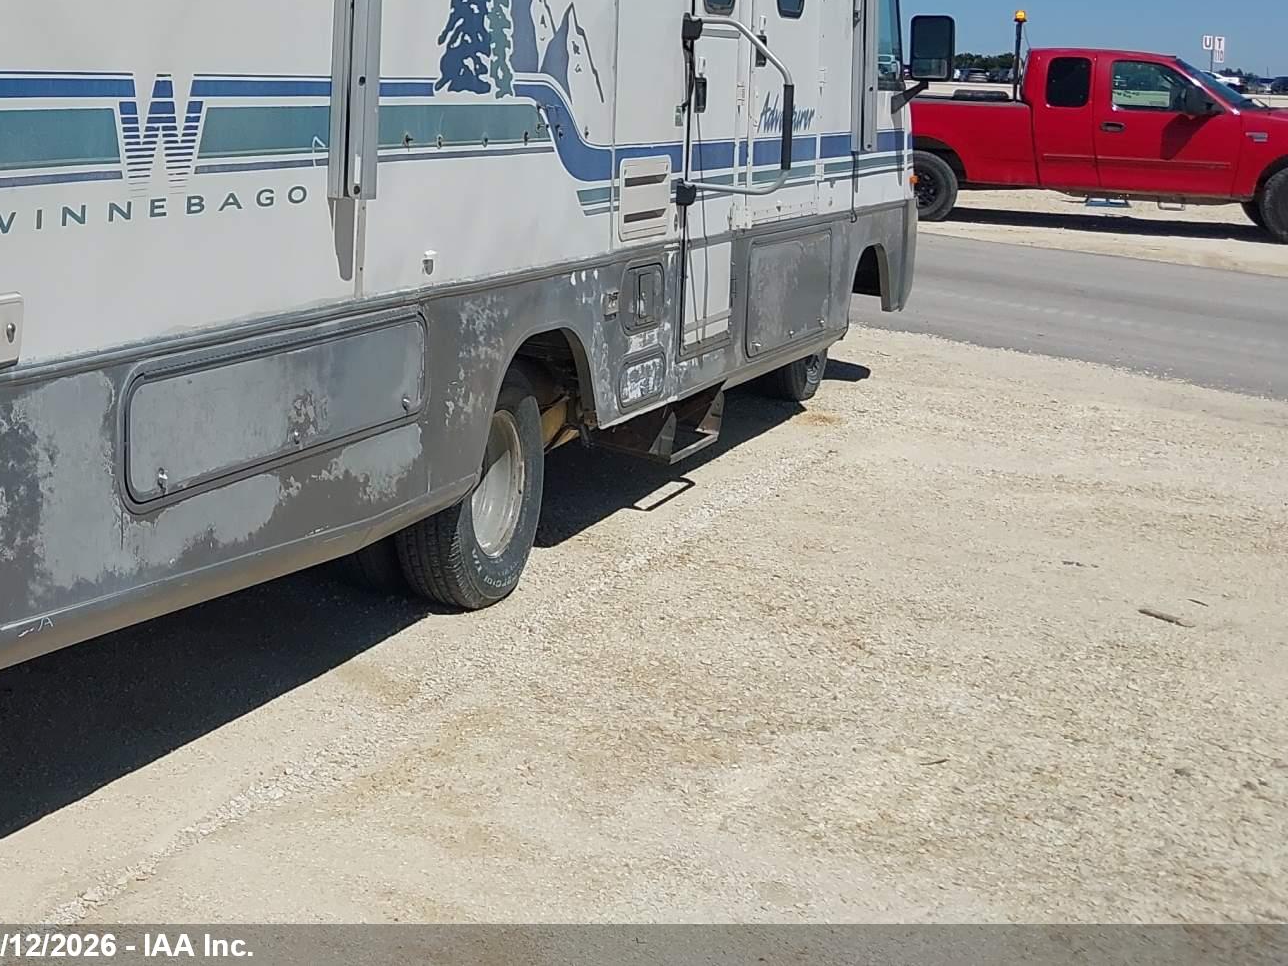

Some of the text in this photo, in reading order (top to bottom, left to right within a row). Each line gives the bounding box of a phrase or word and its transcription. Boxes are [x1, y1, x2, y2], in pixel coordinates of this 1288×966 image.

[1205, 37, 1211, 48] U
[1217, 38, 1222, 49] T
[756, 91, 815, 133] Advurer
